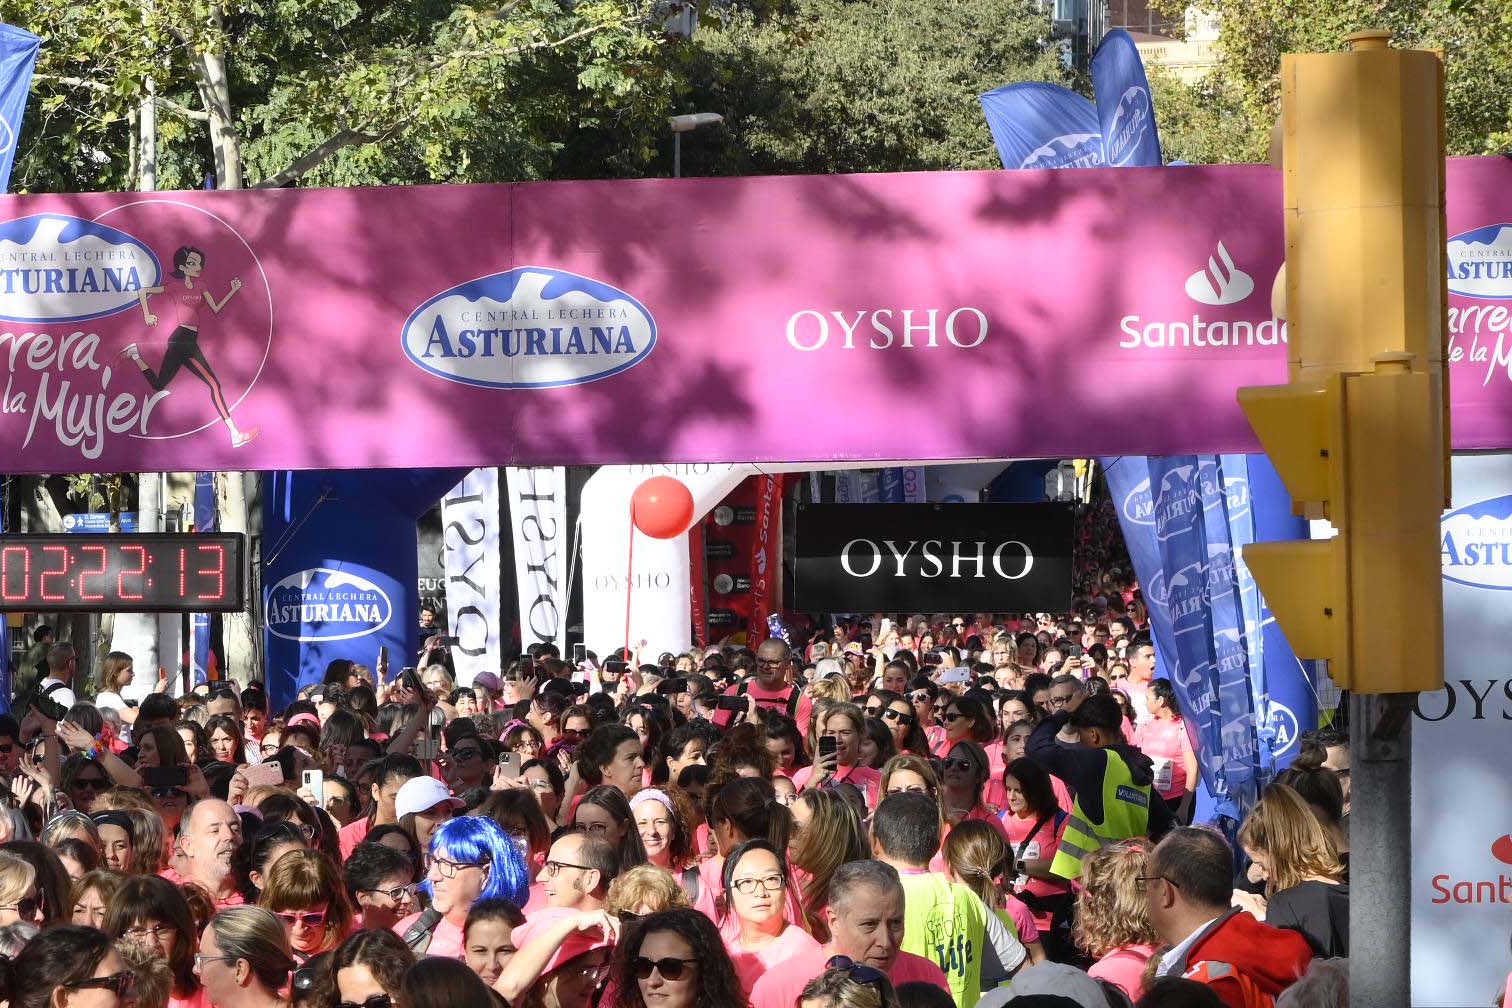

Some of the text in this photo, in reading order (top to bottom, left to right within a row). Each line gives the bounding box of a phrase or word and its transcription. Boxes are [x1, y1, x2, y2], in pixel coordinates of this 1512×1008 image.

[64, 249, 137, 262] LECHERA
[461, 307, 629, 322] CENTRAL LECHERA
[787, 307, 989, 351] OYSHO
[1119, 314, 1289, 350] Santand
[422, 313, 637, 360] ASTURIANA
[1470, 335, 1488, 362] la
[3, 375, 26, 413] la
[22, 365, 171, 459] Mujer
[1, 546, 223, 600] 02:22:13
[841, 538, 1034, 579] OYSHO
[270, 598, 382, 625] ASTURIANA
[328, 592, 378, 601] LECHERA
